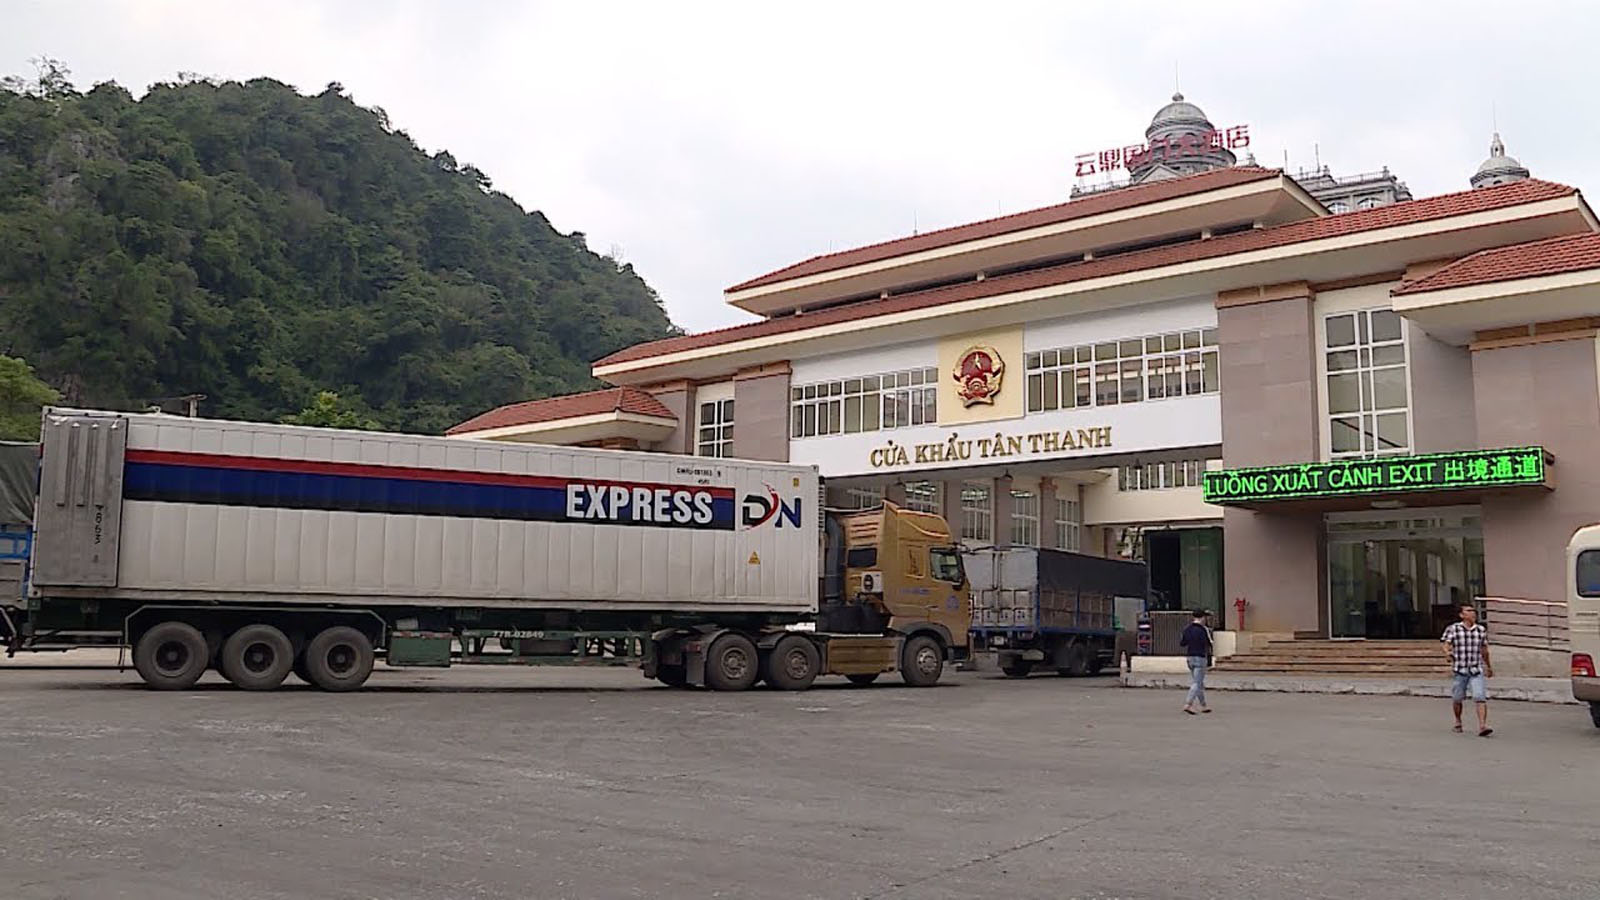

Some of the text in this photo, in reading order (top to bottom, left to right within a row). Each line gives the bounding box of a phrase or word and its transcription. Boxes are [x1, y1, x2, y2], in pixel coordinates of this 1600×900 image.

[870, 426, 1113, 468] CỬA KHẨU TÂN THANH
[1272, 464, 1323, 492] XUẤT
[1328, 462, 1383, 488] CẢNH
[1389, 462, 1437, 484] EXIT
[1444, 454, 1539, 481] 出境通道
[566, 484, 714, 524] EXPRESS
